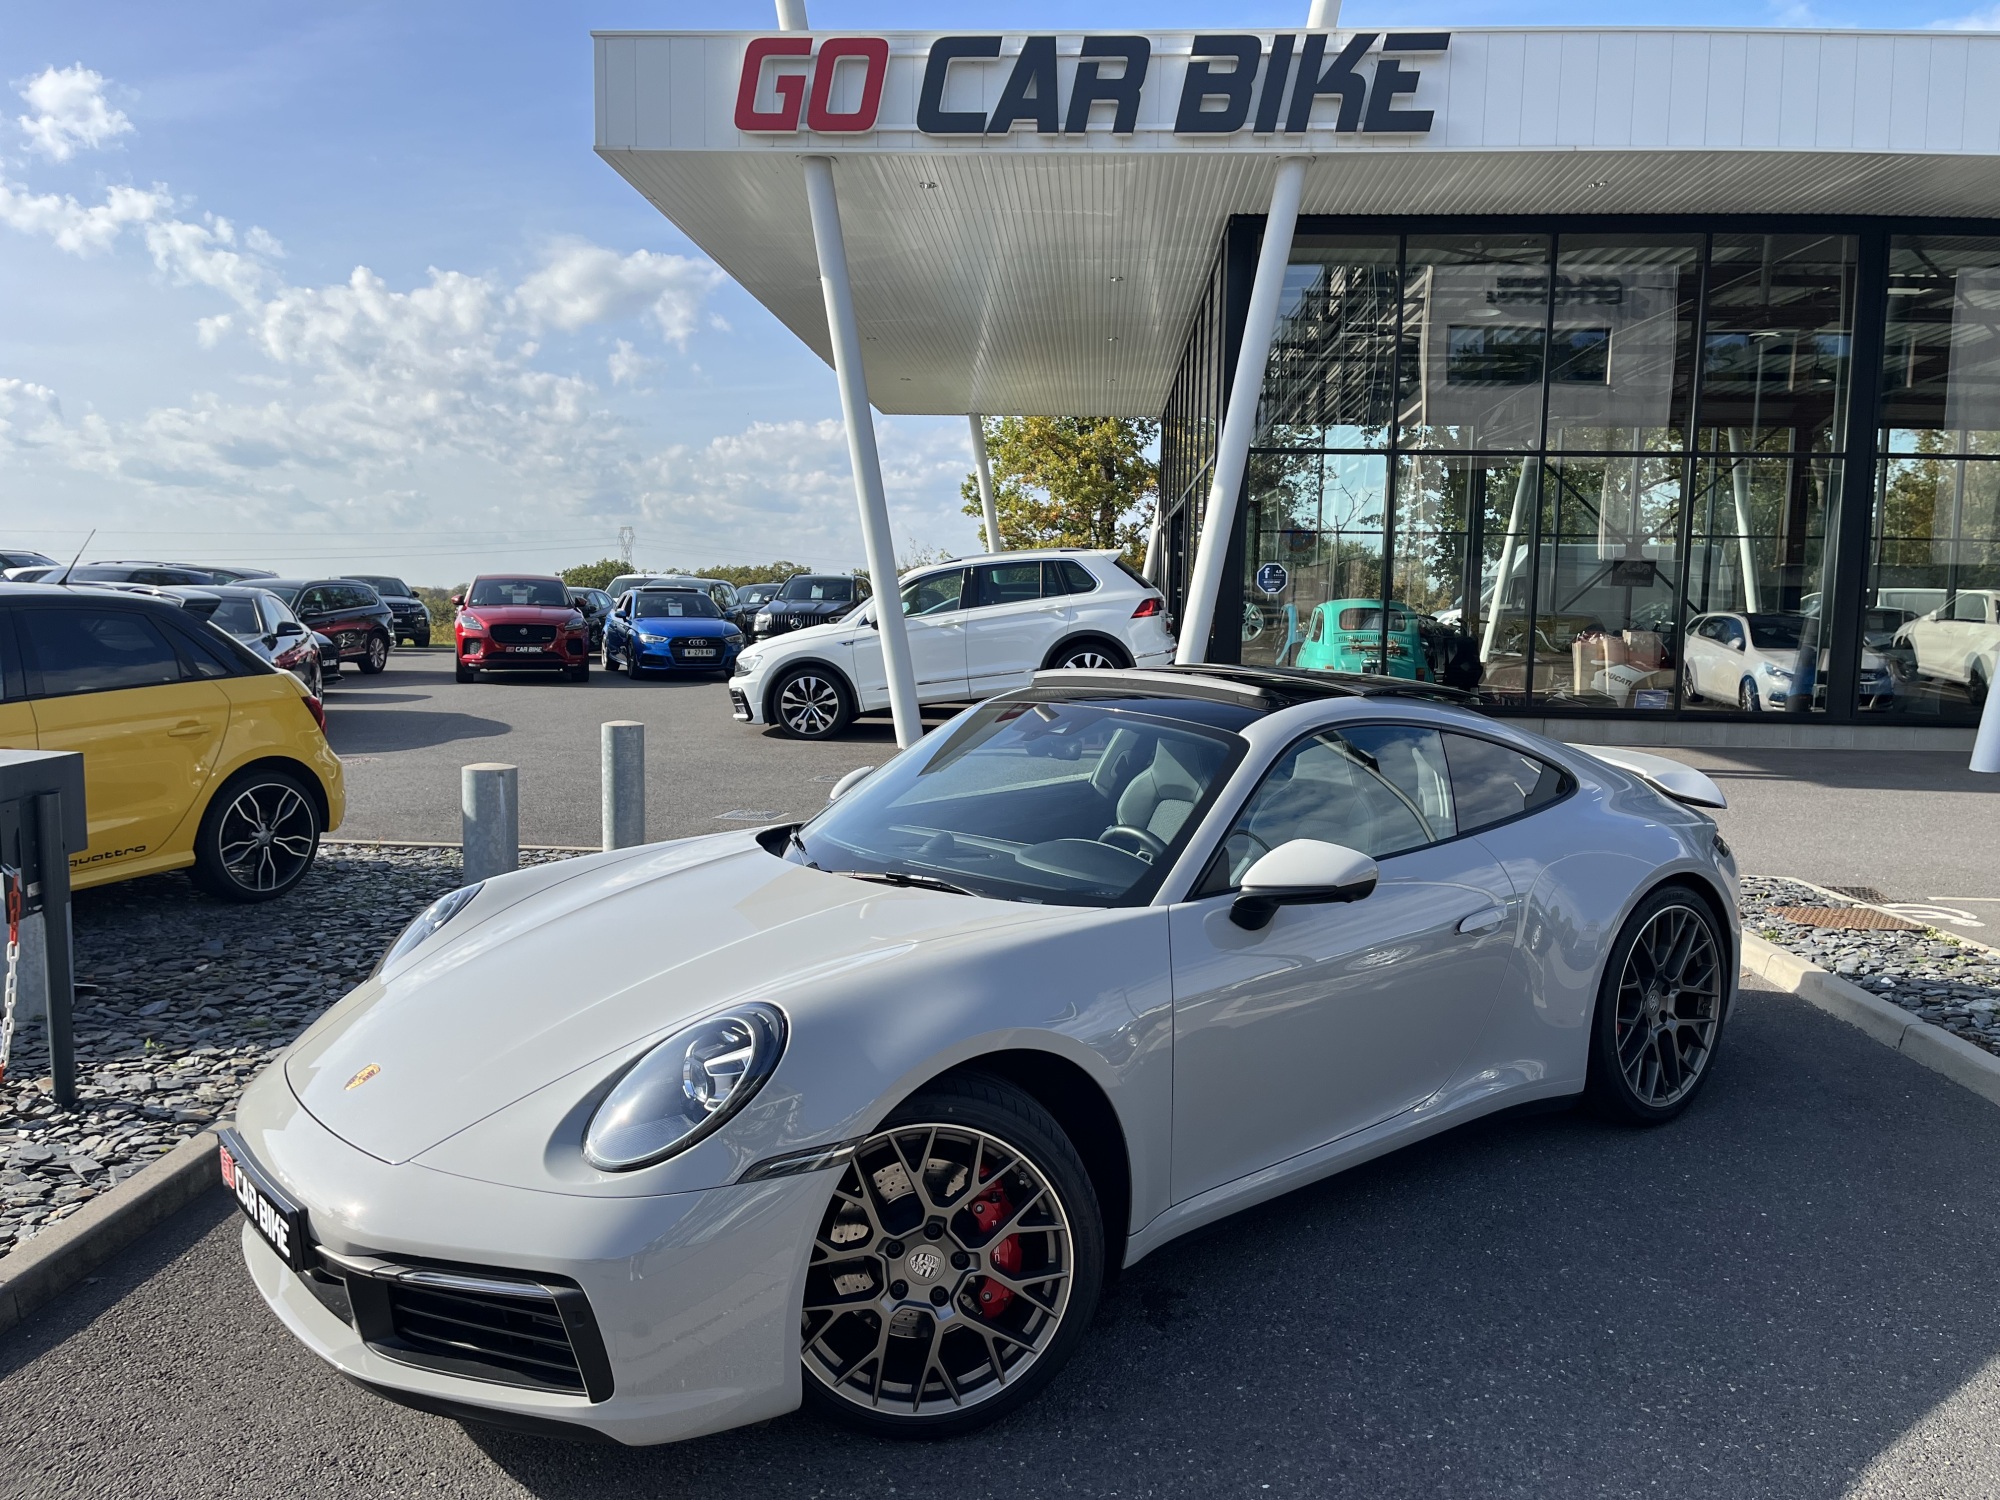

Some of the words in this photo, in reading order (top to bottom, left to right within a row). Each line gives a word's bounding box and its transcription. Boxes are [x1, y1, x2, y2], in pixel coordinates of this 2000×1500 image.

[734, 37, 890, 134] GO
[916, 35, 1152, 135] CAR
[1173, 32, 1452, 134] BIKE
[1603, 671, 1633, 687] DUCATI
[235, 1165, 258, 1221] CAR
[258, 1194, 291, 1258] BIKE
